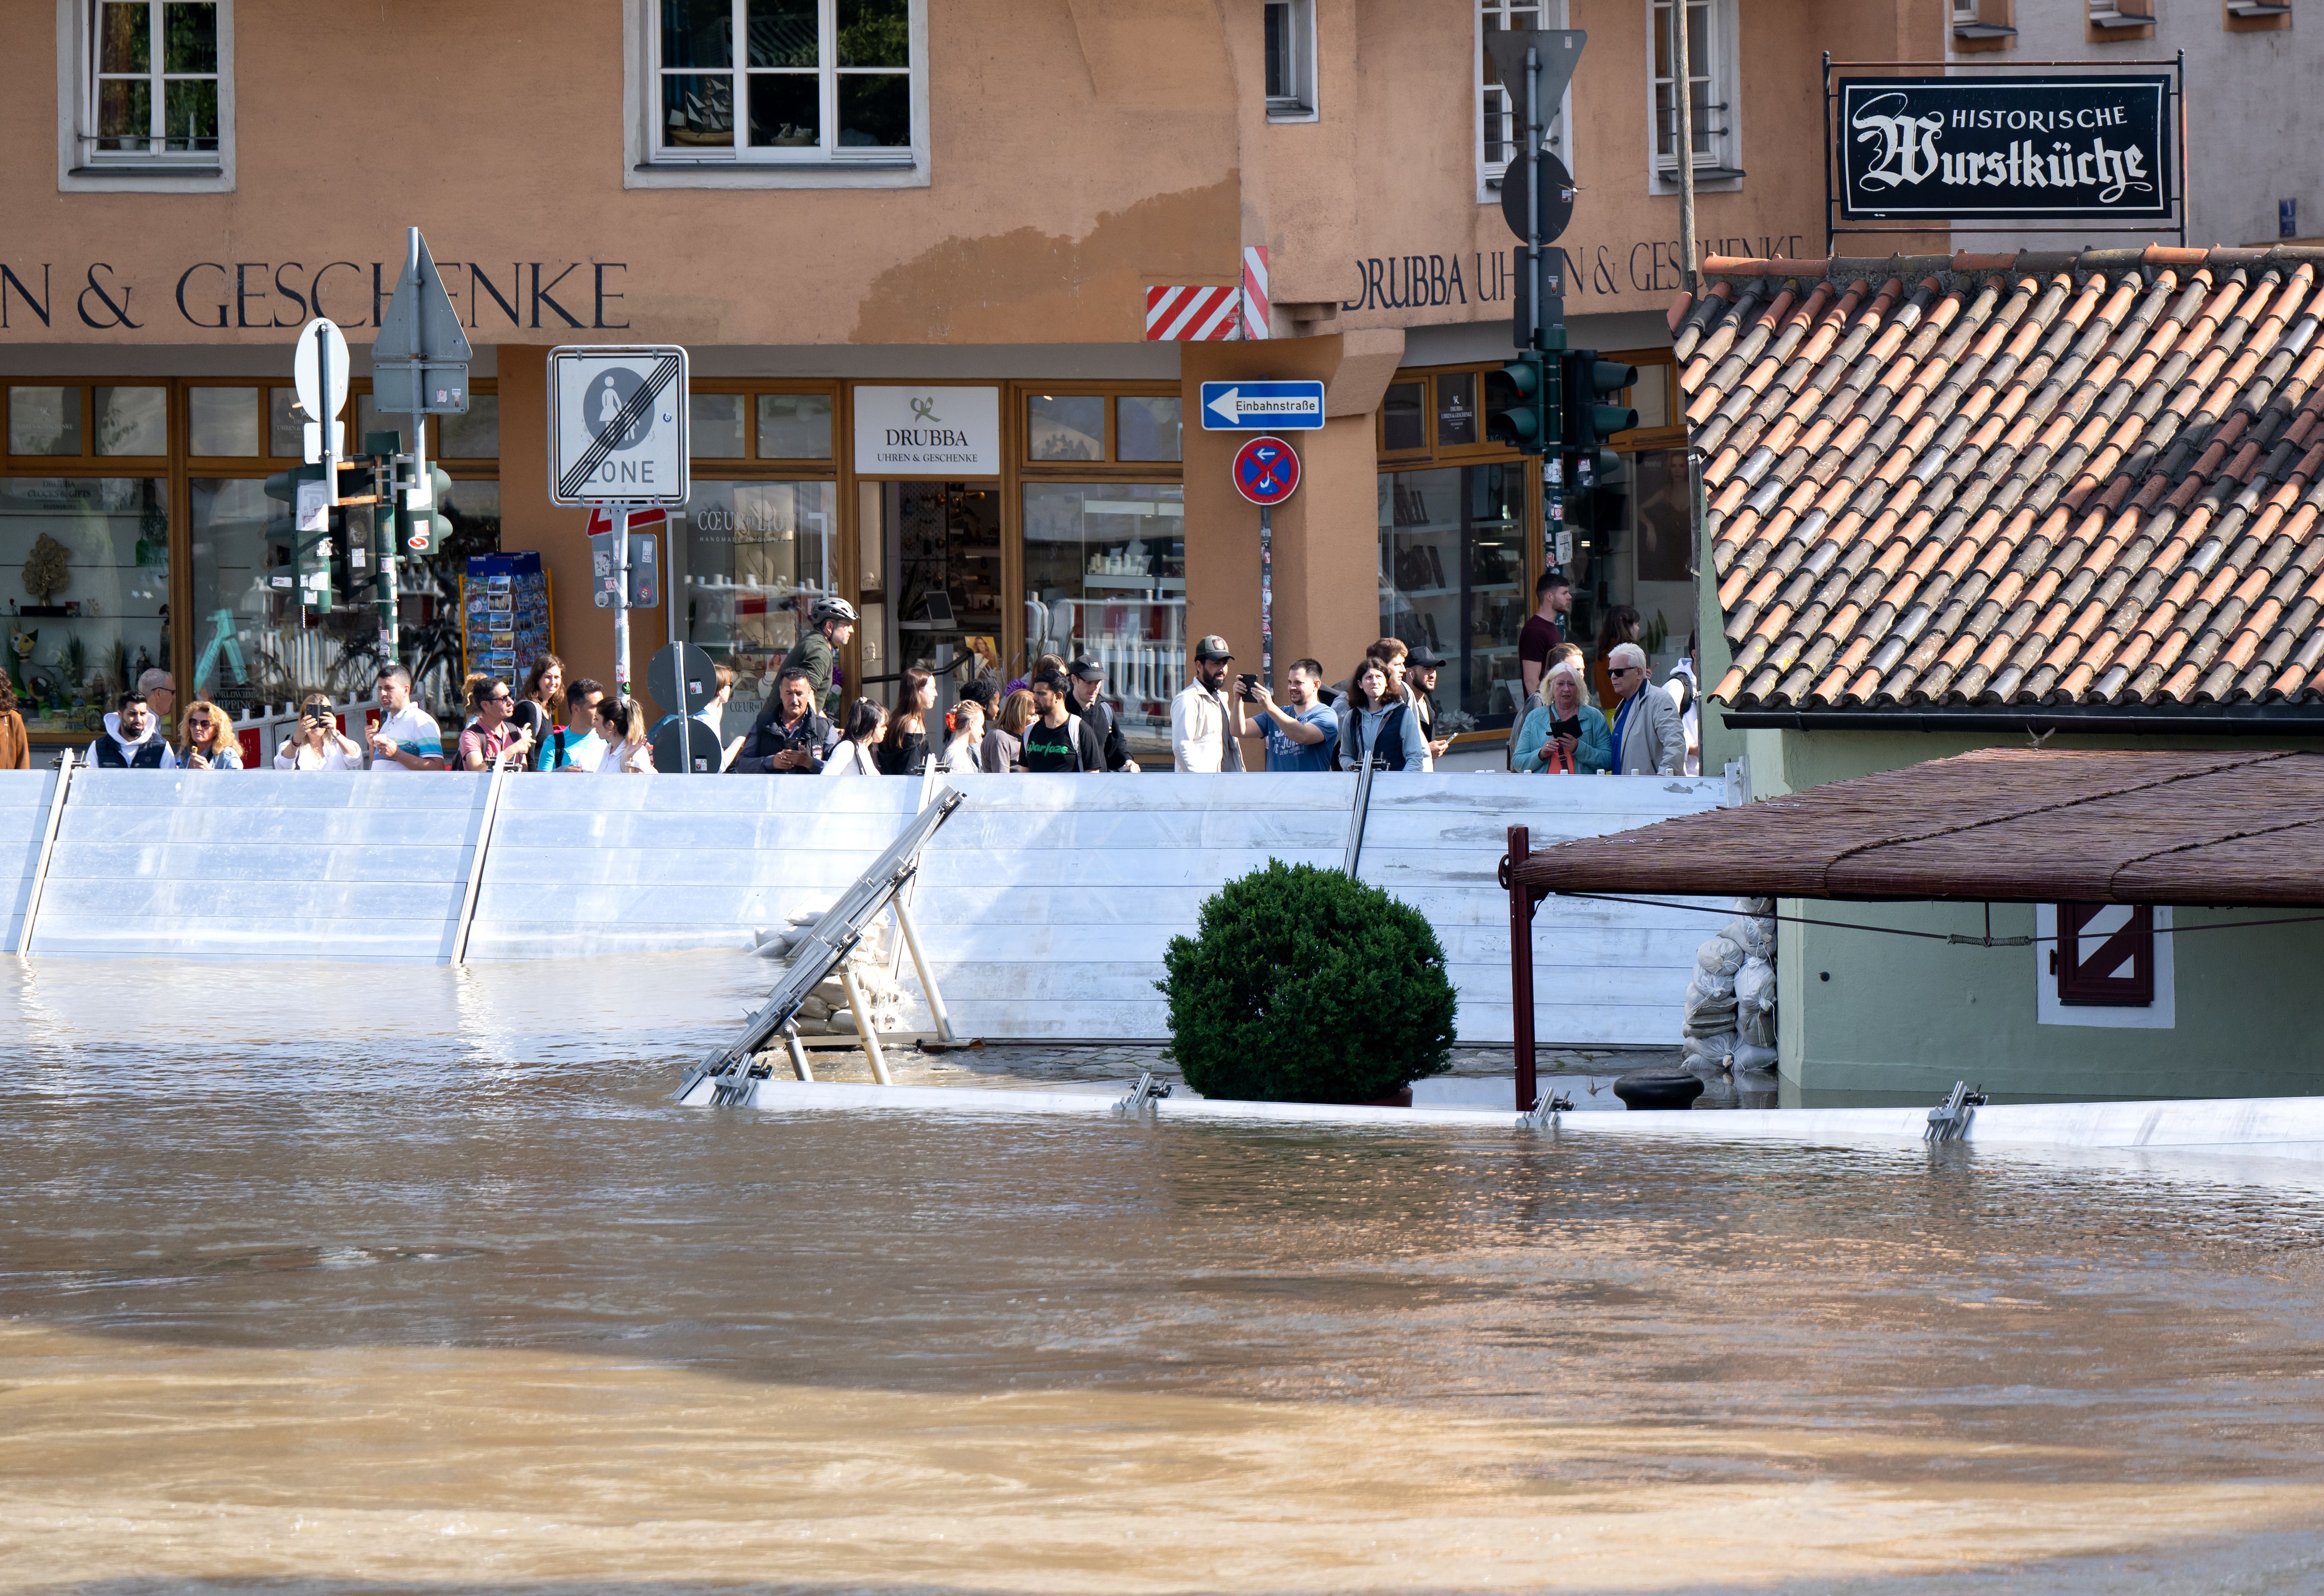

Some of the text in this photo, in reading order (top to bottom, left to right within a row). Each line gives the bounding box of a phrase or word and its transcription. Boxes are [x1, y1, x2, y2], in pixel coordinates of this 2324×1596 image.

[1952, 106, 2127, 132] HISTORISCHE
[1852, 92, 2153, 204] Wurstküche
[1342, 253, 1467, 311] DRUBBA
[1475, 247, 1584, 302] UHN
[1594, 245, 1620, 294] &
[78, 263, 144, 329] &
[1236, 400, 1315, 411] Einbahnstraße
[885, 429, 969, 446] DRUBBA
[877, 453, 978, 462] UHREN & GESCHENKE
